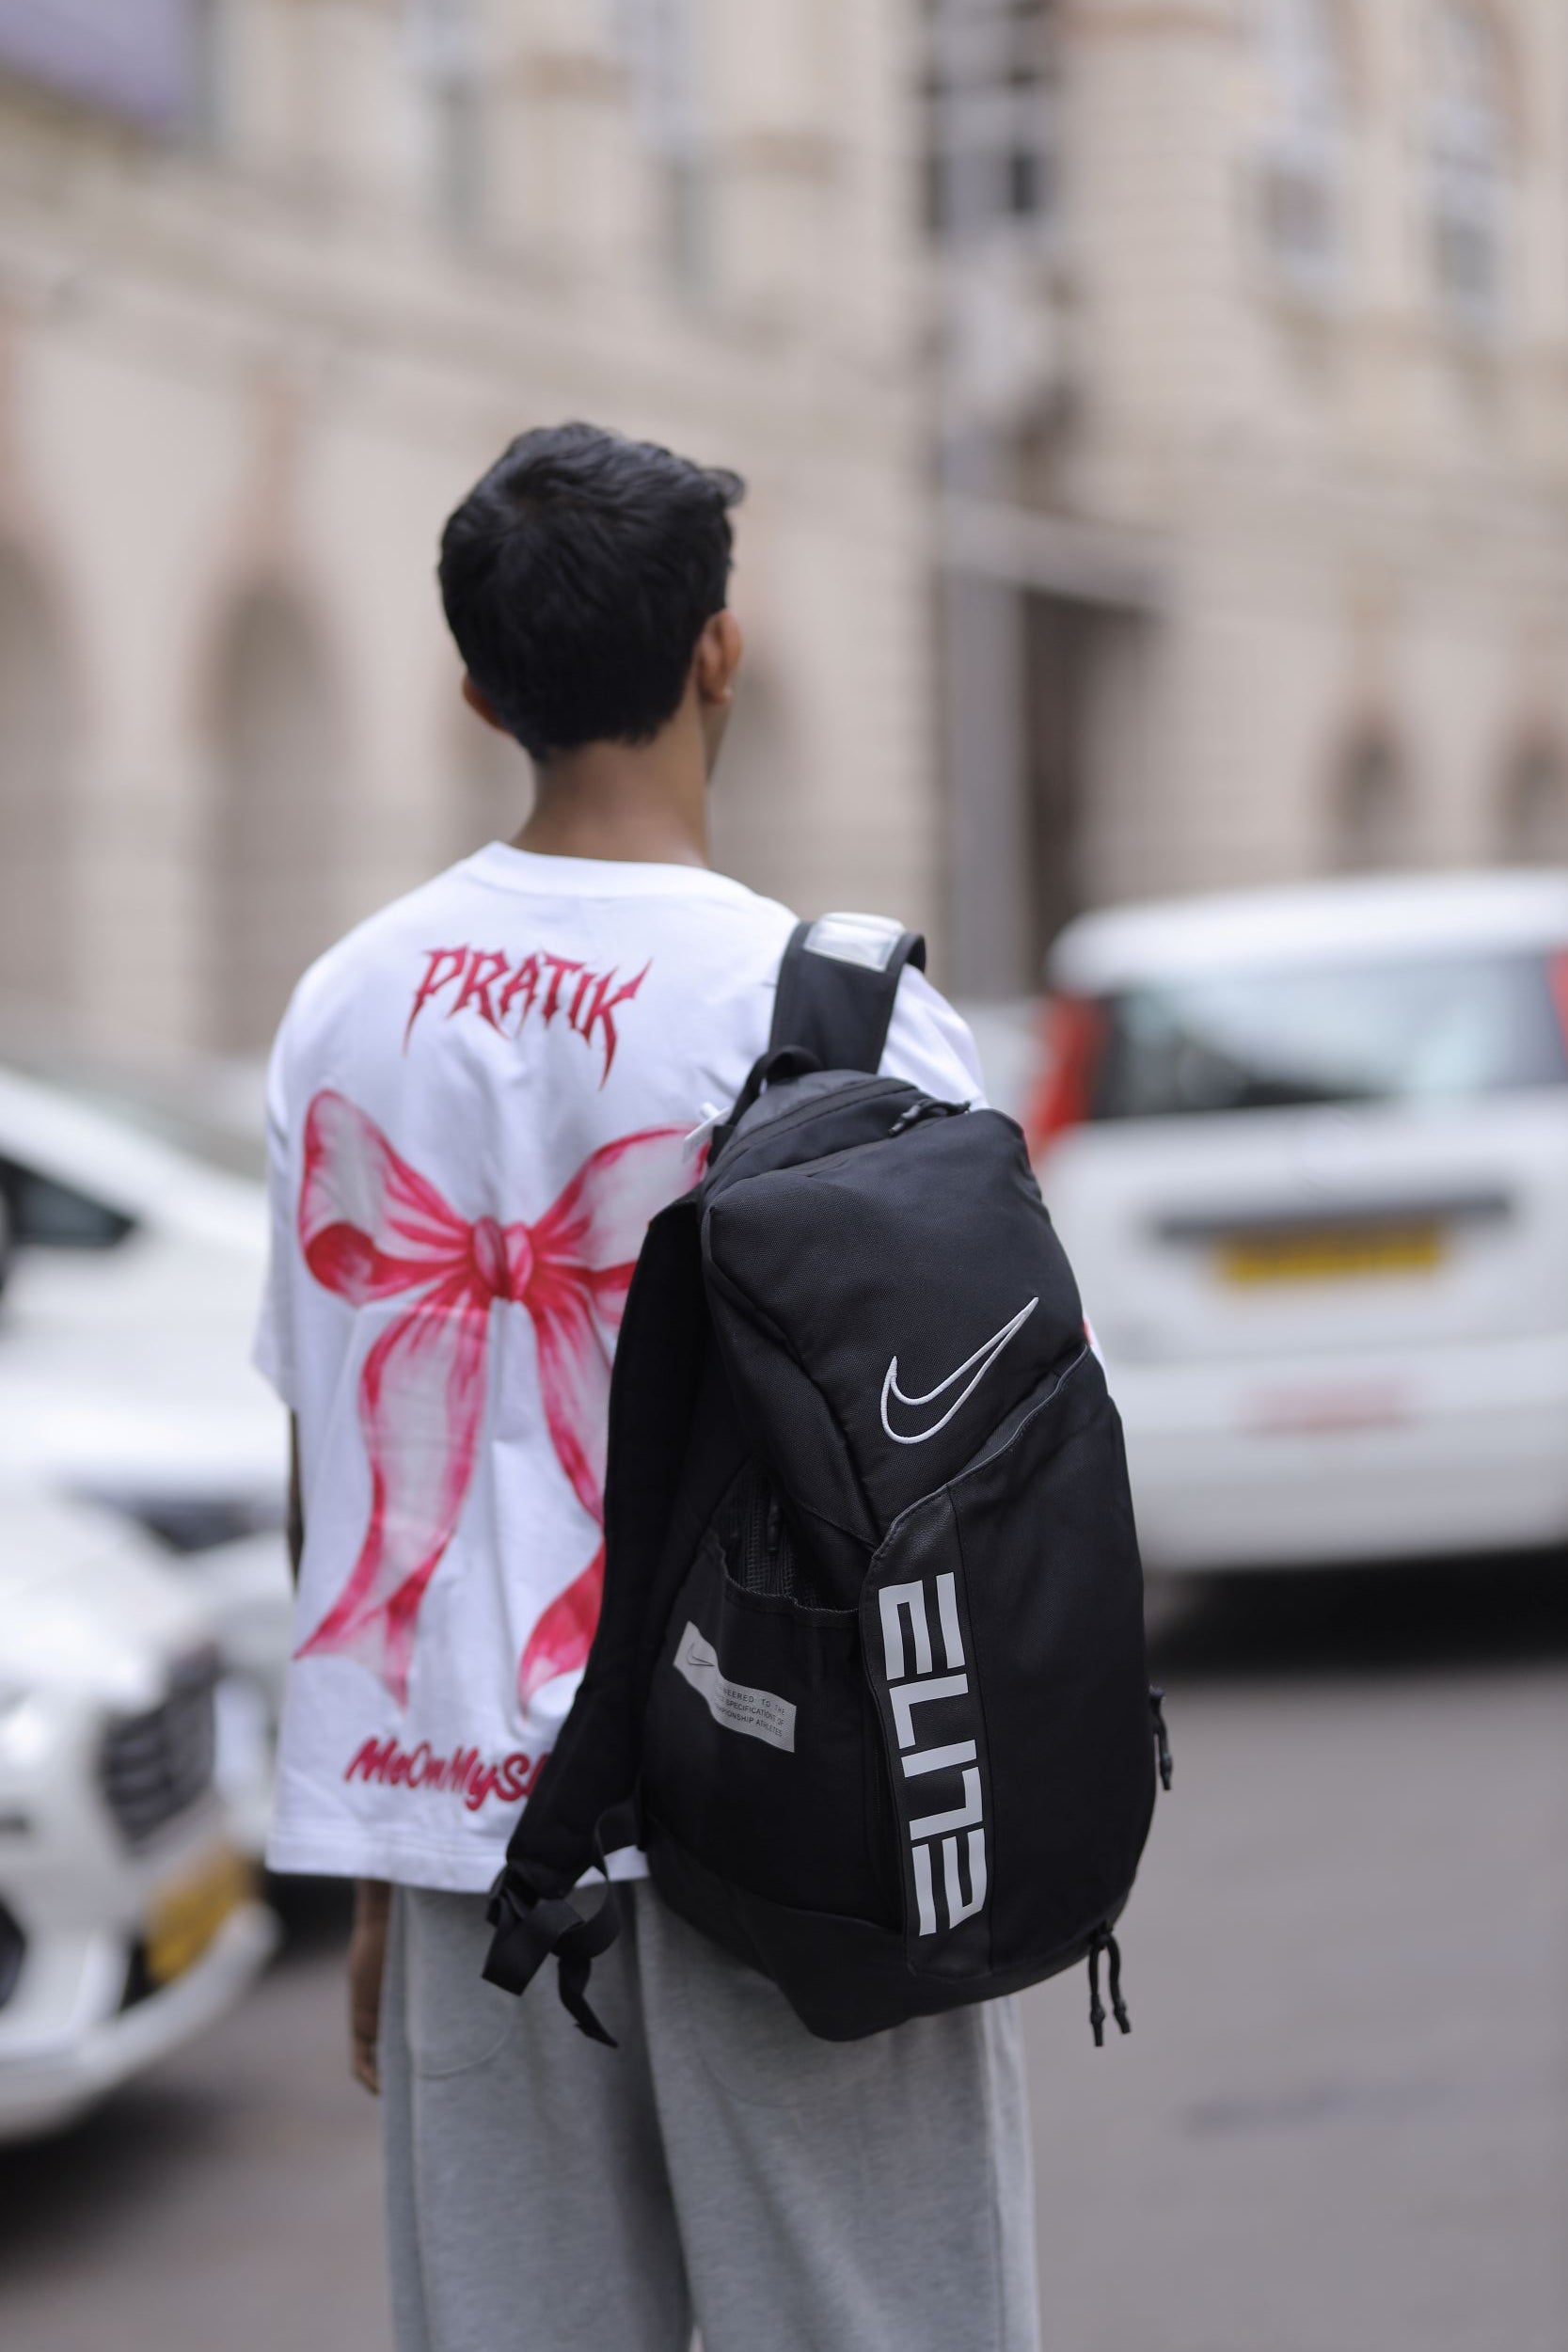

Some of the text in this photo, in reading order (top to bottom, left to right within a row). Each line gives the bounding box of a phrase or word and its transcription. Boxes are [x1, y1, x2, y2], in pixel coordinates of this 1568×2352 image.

[402, 943, 653, 1091] PRATIK
[725, 1699, 784, 1726] SPECIFICATIONS OF
[762, 1698, 771, 1708] TO
[775, 1704, 784, 1715] THE
[755, 1719, 783, 1738] ATHLETES
[879, 1572, 987, 1936] ELITE
